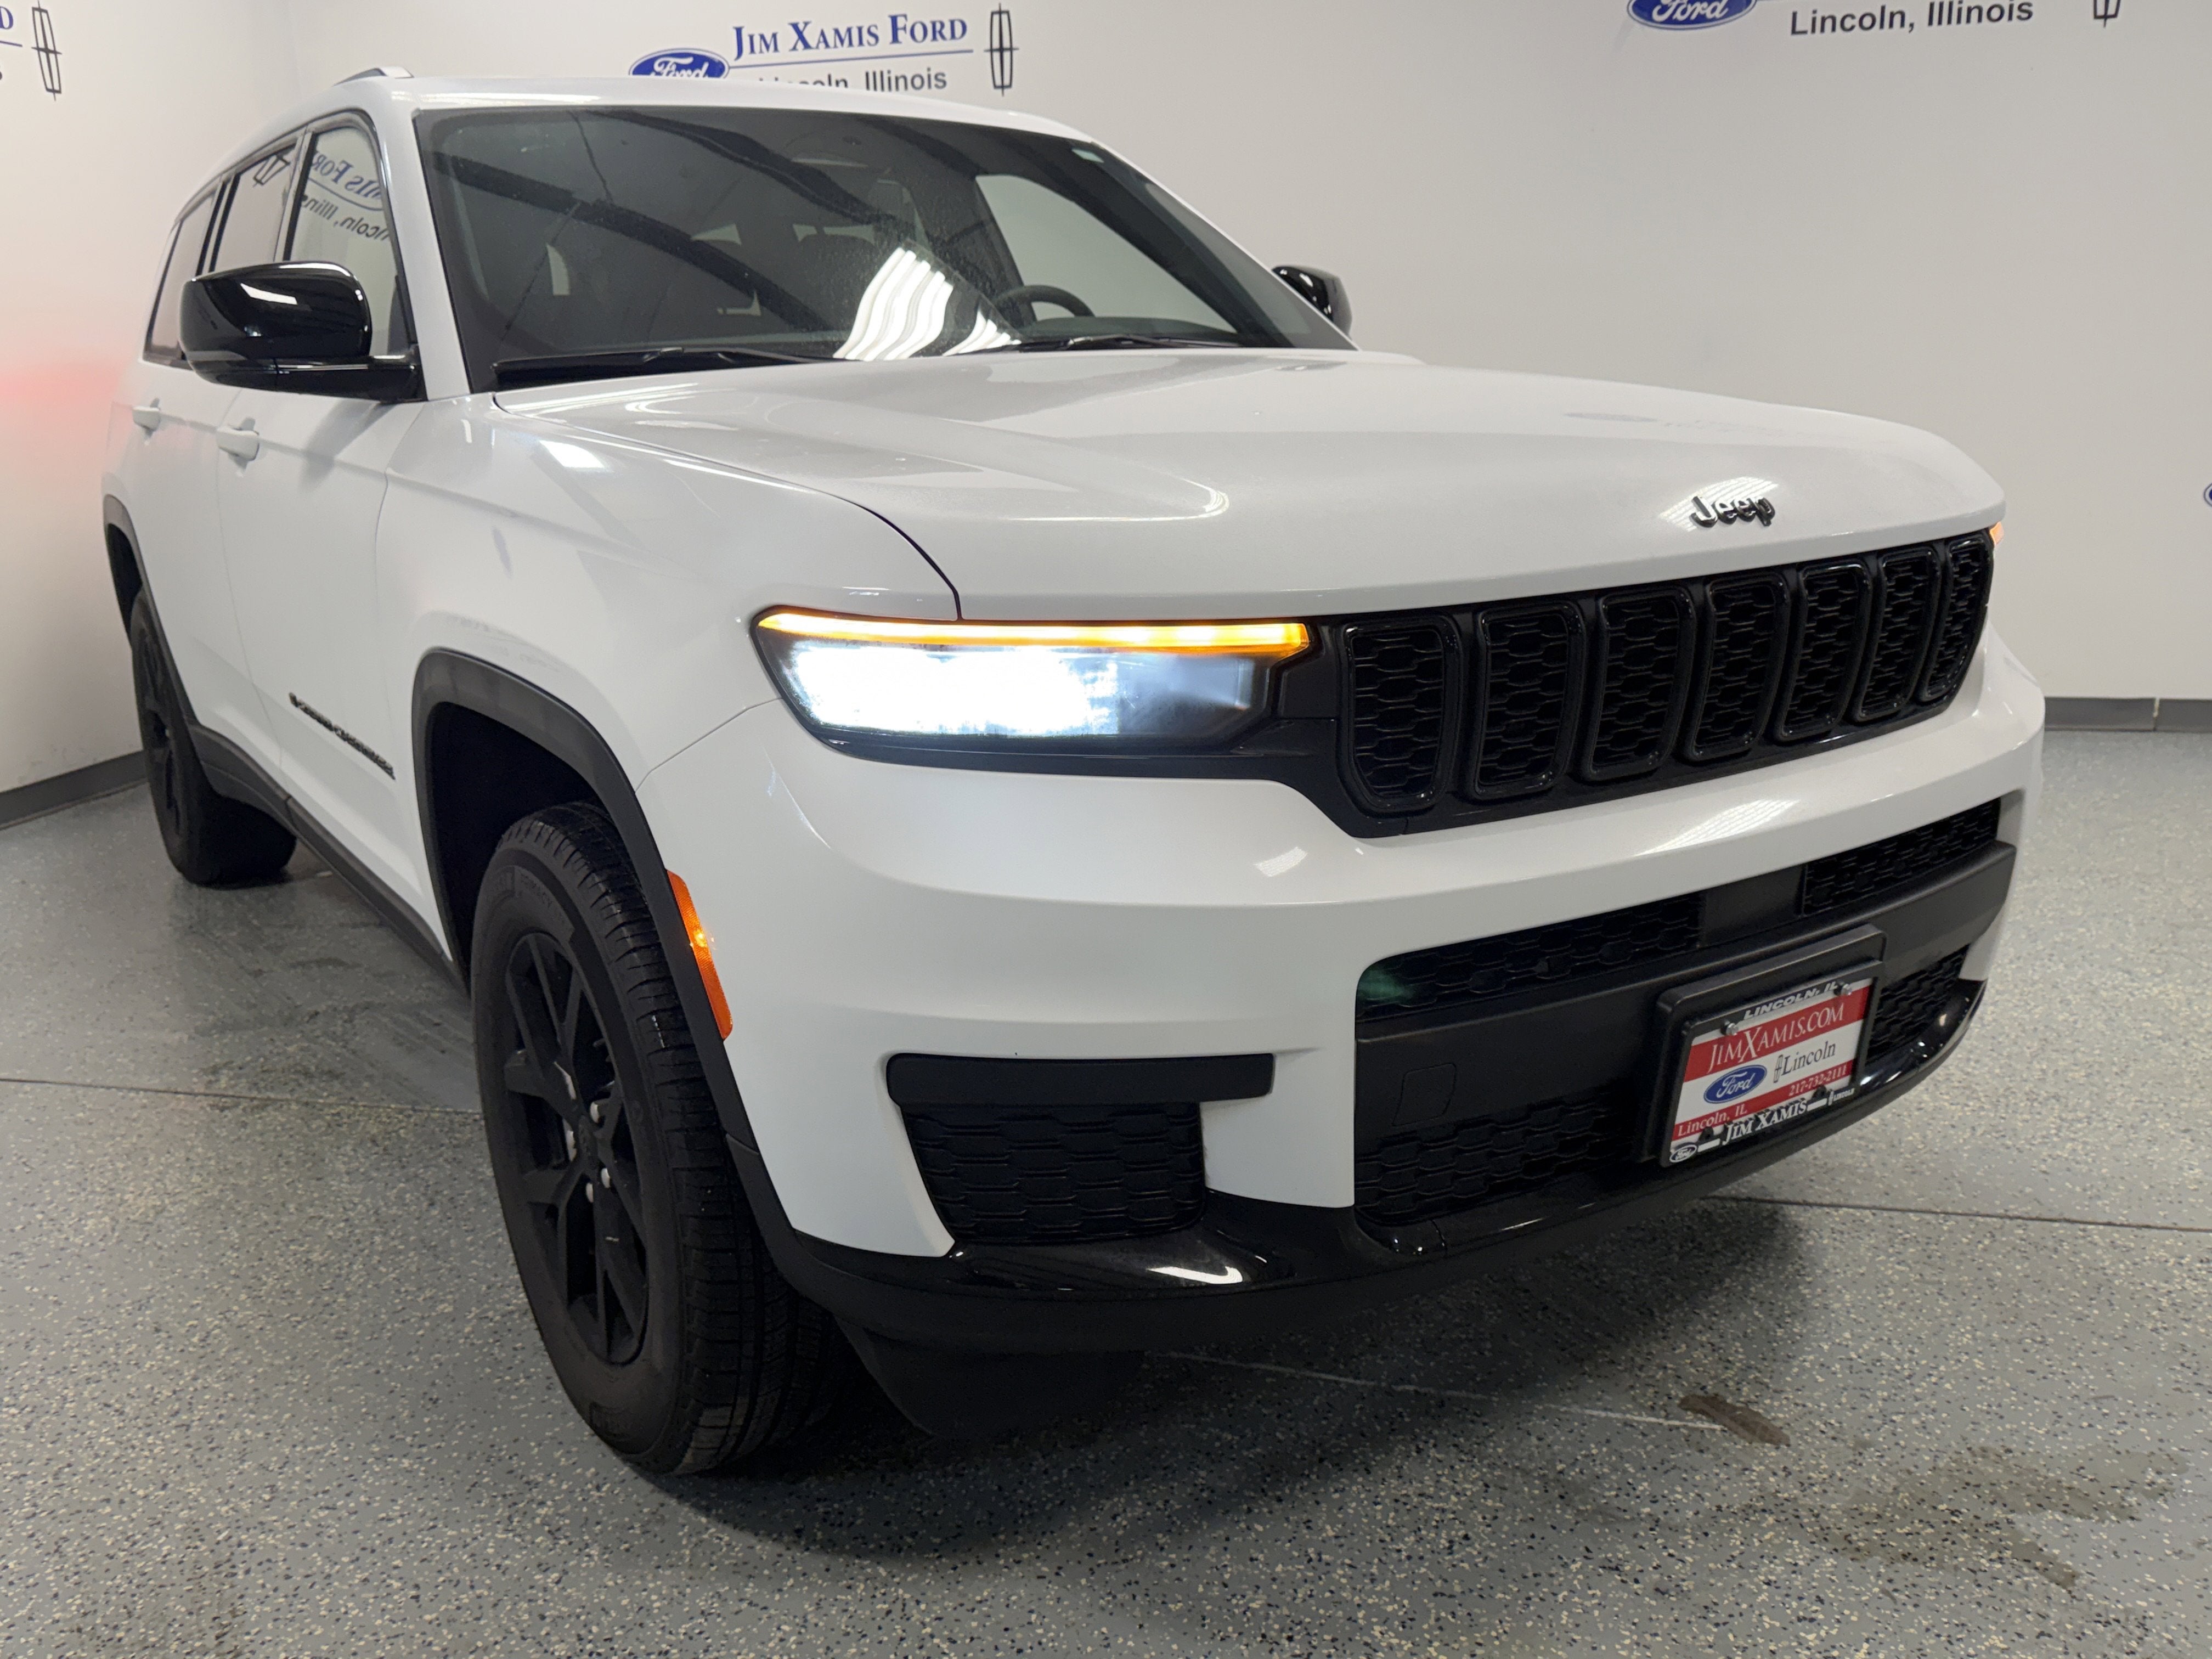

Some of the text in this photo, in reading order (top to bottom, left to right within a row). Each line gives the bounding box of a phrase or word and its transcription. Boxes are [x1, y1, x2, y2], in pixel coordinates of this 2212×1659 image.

[1652, 0, 1728, 22] Ford
[1790, 0, 2033, 36] Lincoln, Illinois
[732, 13, 968, 61] JIM XAMIS FORD
[865, 67, 947, 92] Illinois
[1689, 495, 1776, 528] Jeep
[1823, 981, 1838, 994] IL
[1707, 1002, 1844, 1074] JIMXAMIS.COM
[1781, 1041, 1836, 1076] Lincoln
[1716, 1071, 1756, 1098] Ford
[1788, 1064, 1847, 1097] 217-732-2111
[1678, 1104, 1748, 1137] Lincoln, IL
[1722, 1099, 1808, 1146] JIM XAMIS
